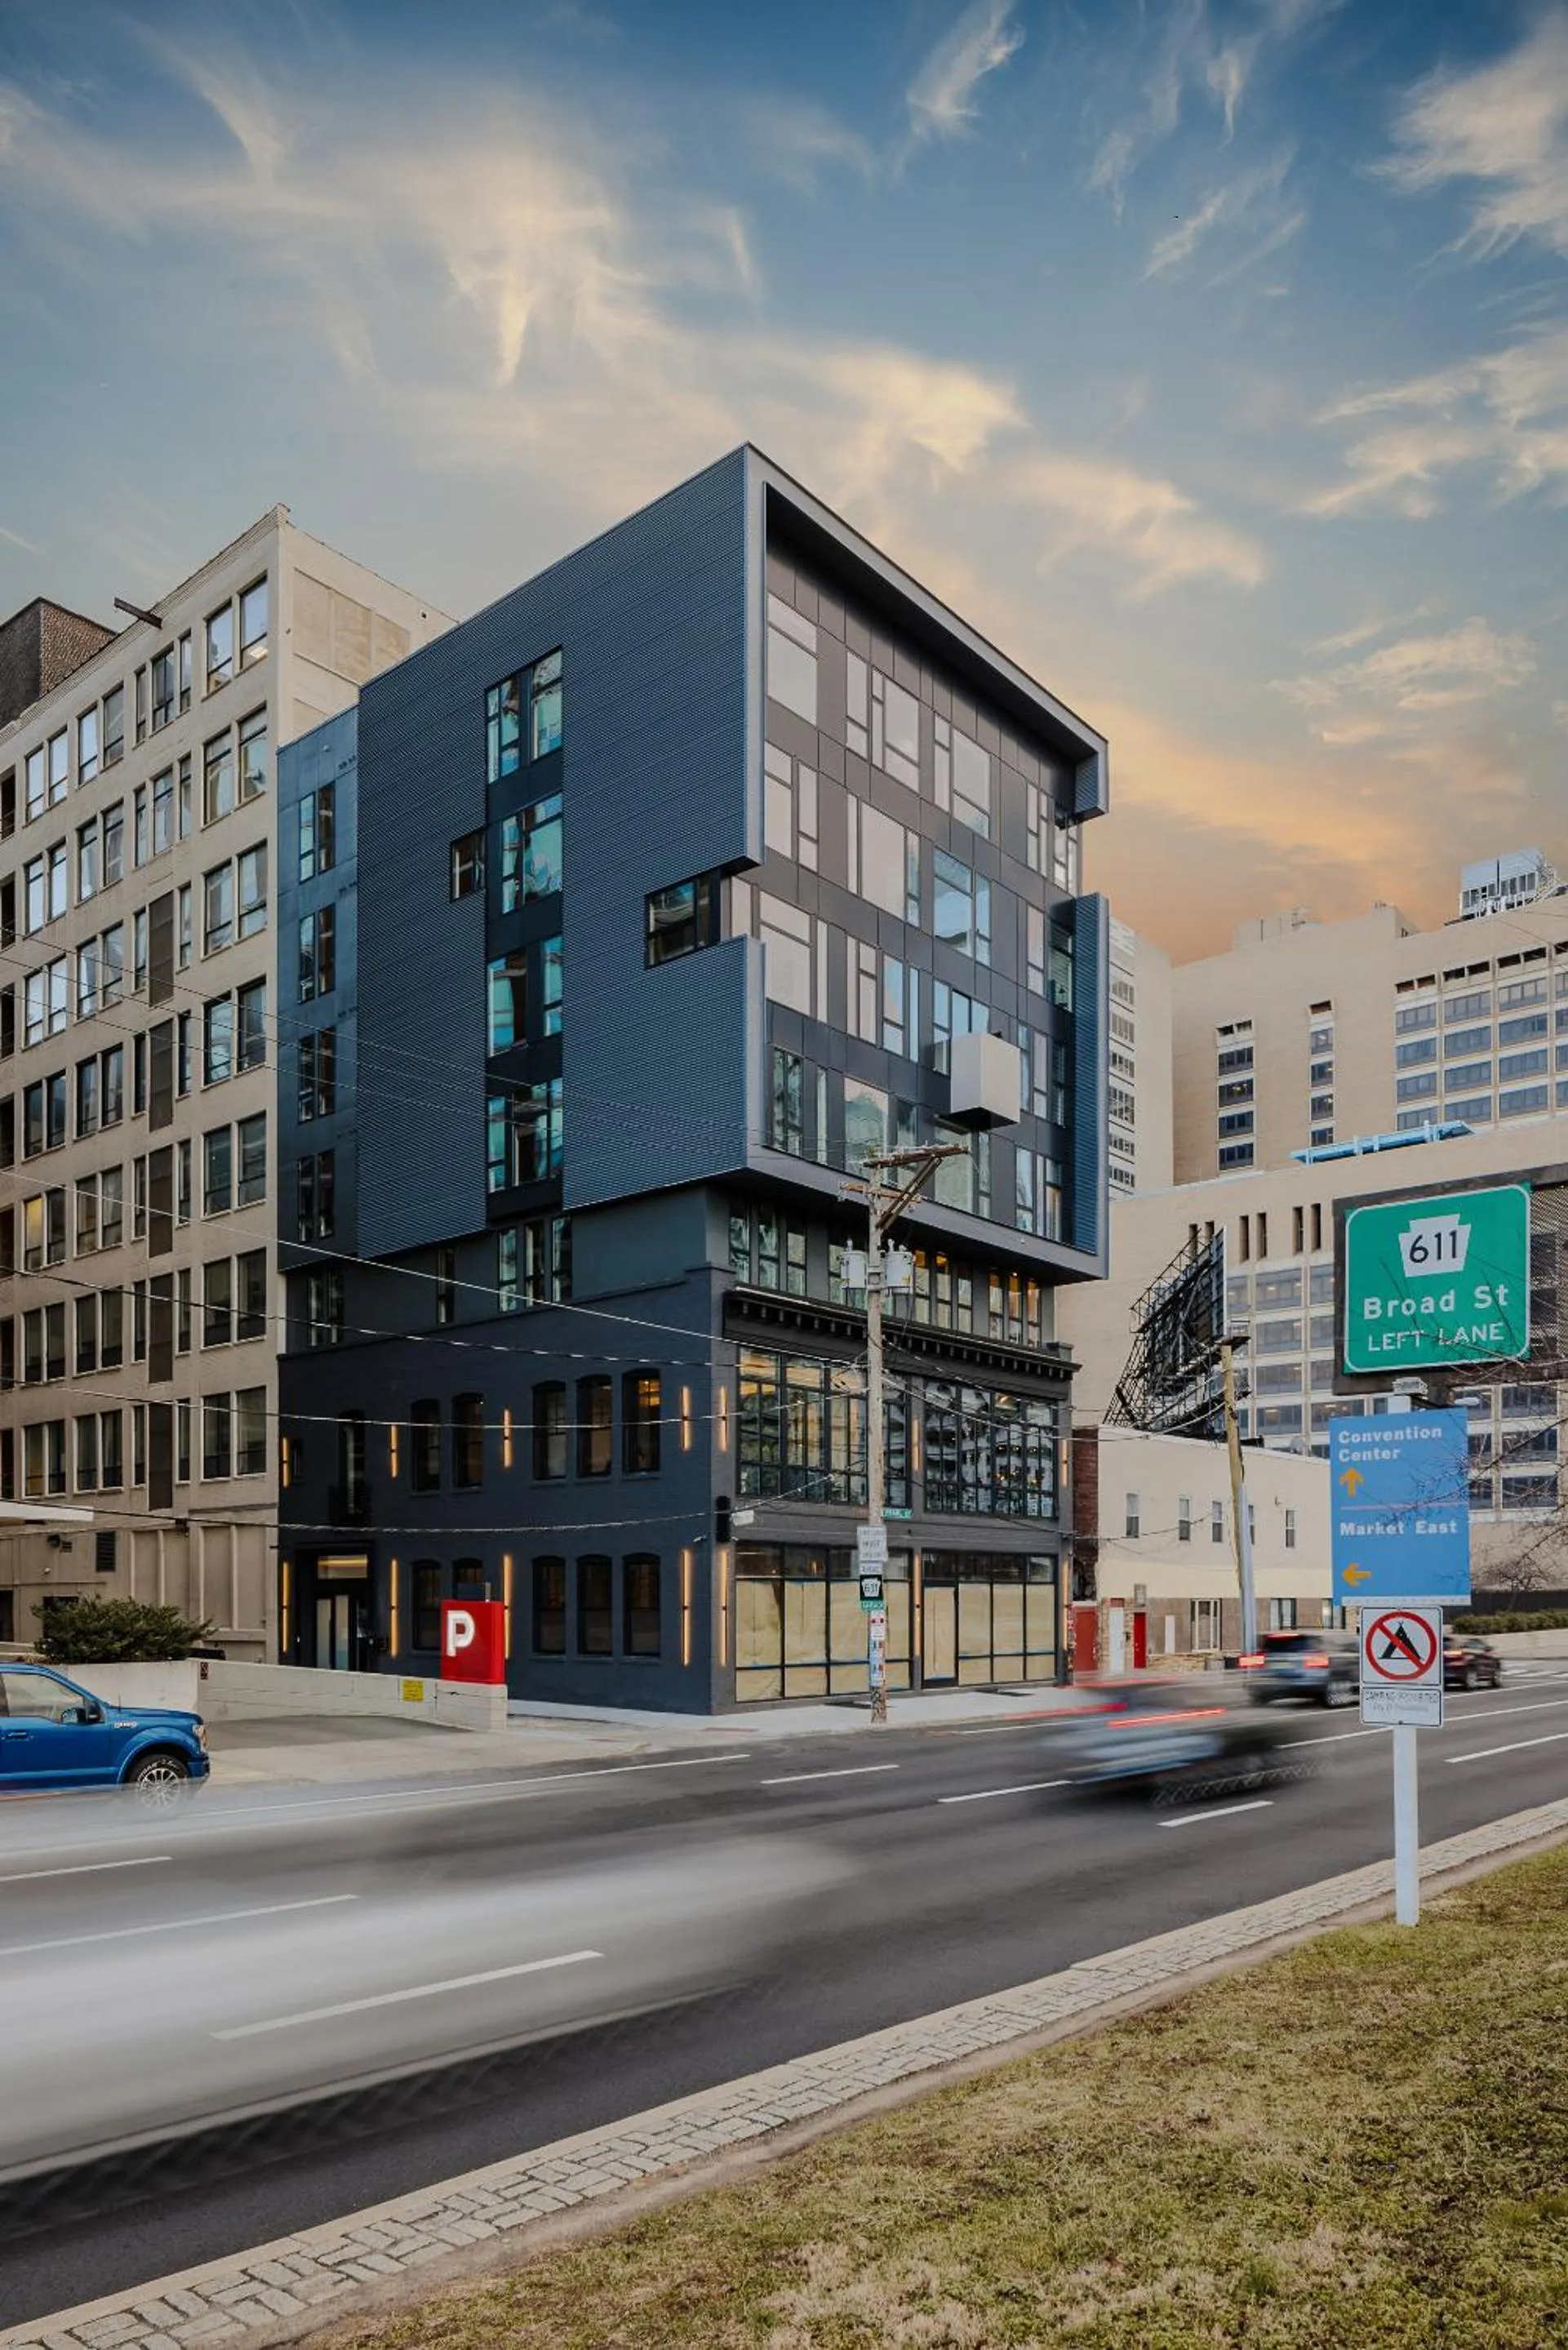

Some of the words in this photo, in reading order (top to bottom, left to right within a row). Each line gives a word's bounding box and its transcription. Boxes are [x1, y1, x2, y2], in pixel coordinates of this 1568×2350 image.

[1410, 1229, 1458, 1264] 611
[1364, 1290, 1455, 1320] Broad
[1474, 1284, 1508, 1309] St
[1368, 1330, 1422, 1352] LEFT
[1439, 1322, 1504, 1345] LANE
[1339, 1427, 1442, 1444] Convention
[1339, 1448, 1401, 1462] Center
[1340, 1522, 1405, 1536] Market
[1415, 1521, 1458, 1535] East
[446, 1610, 475, 1657] P
